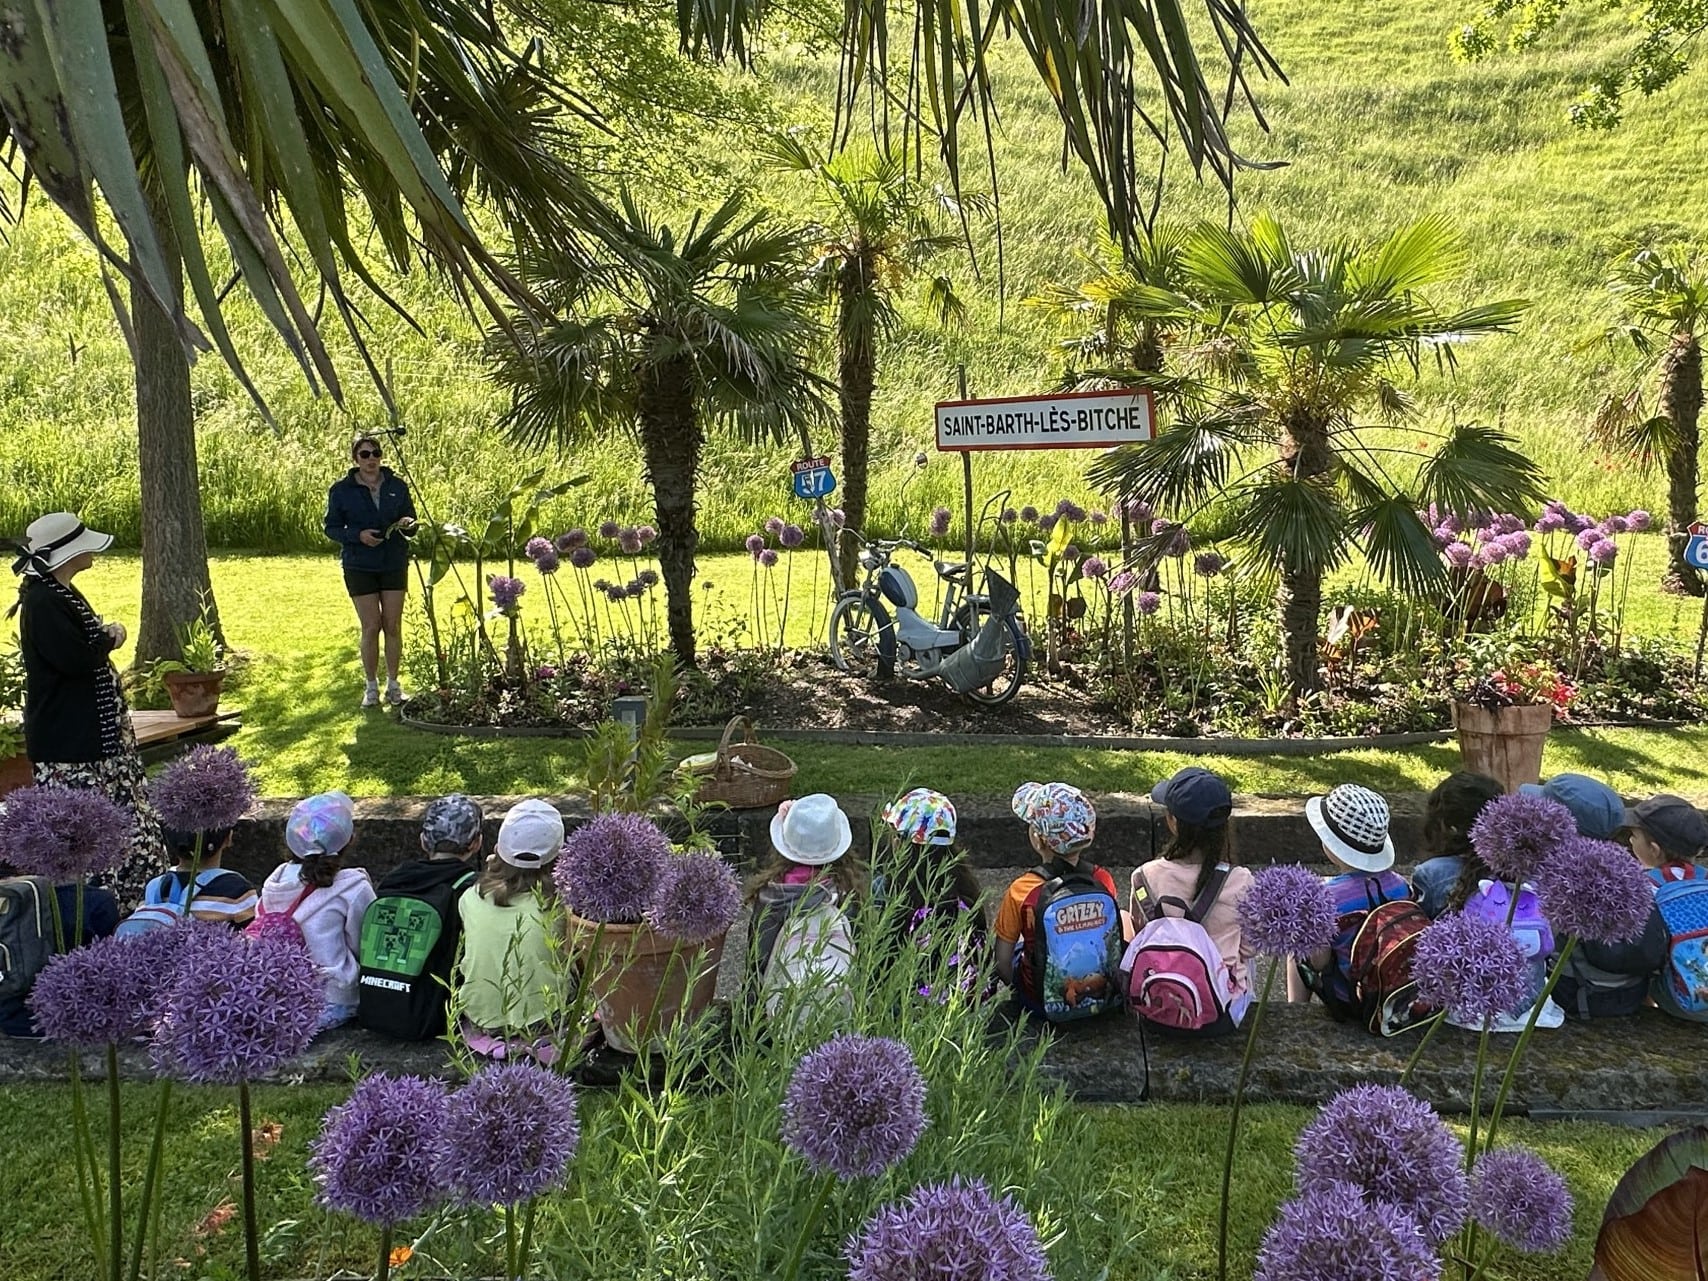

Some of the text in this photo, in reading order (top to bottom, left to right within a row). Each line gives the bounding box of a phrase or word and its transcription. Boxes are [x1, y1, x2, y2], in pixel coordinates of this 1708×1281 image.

[796, 459, 825, 471] ROUTE
[801, 470, 827, 494] 57
[1056, 902, 1104, 925] GRIZZY
[360, 975, 411, 993] MINECRAFT
